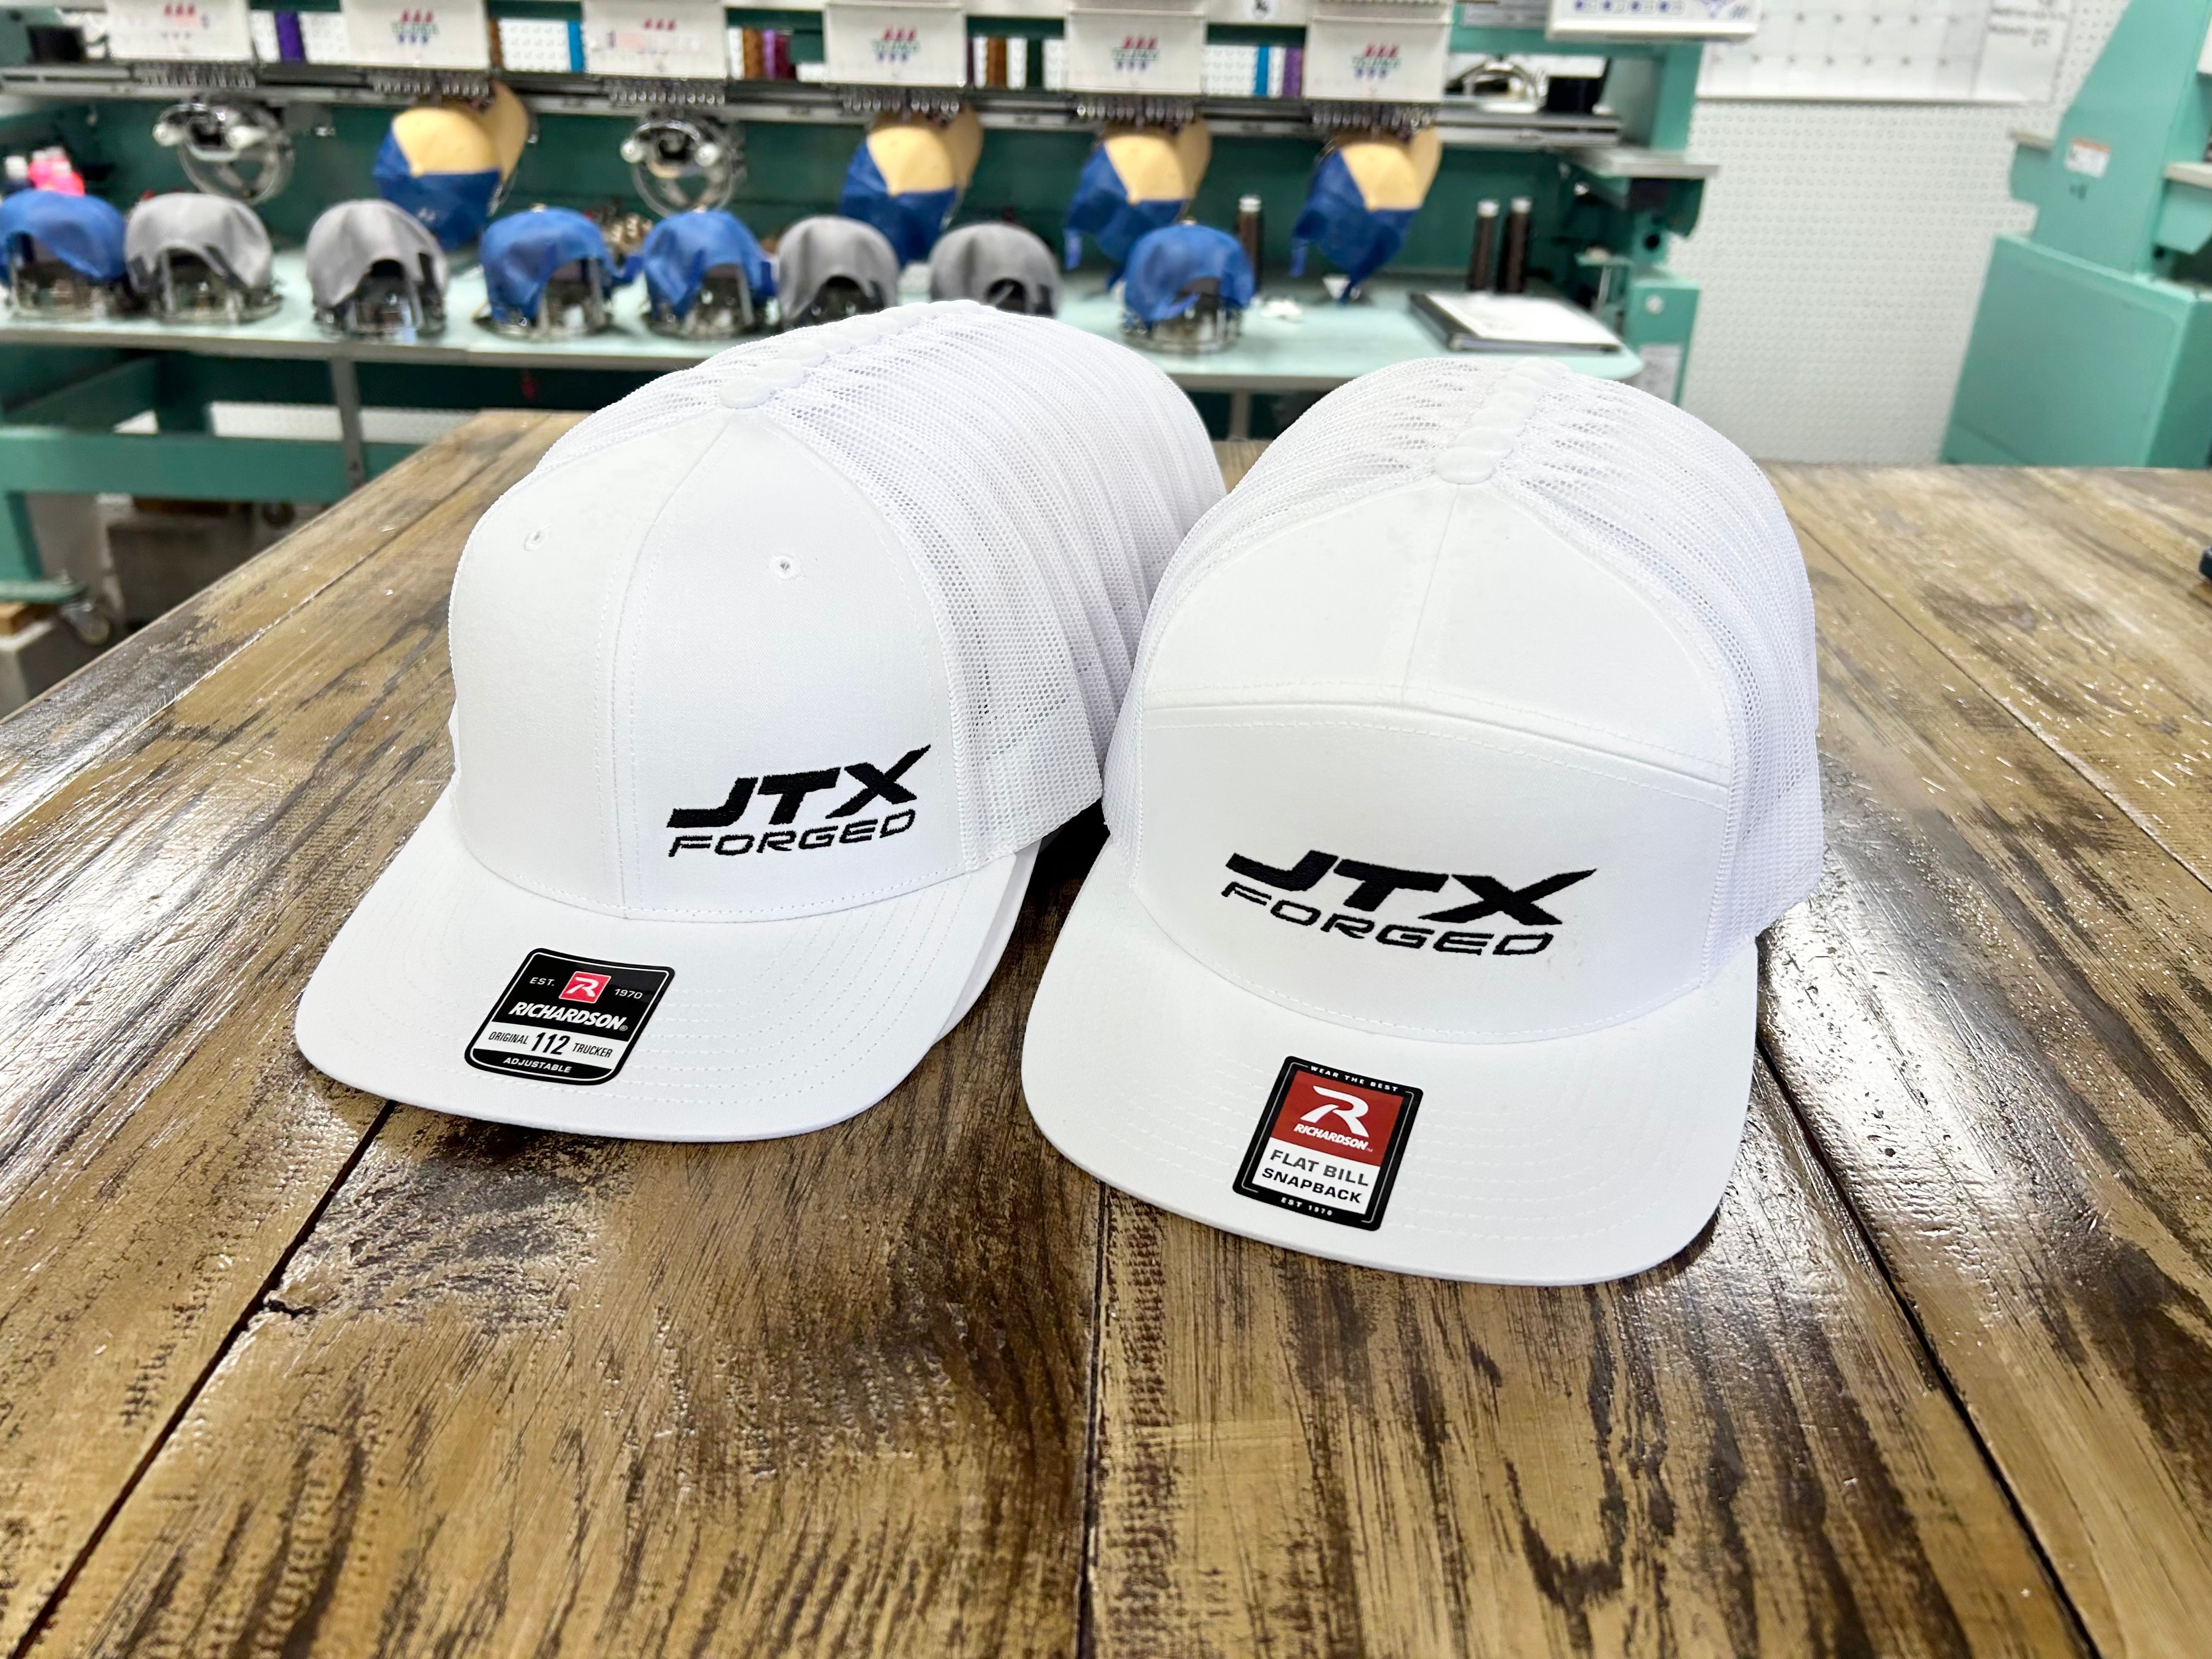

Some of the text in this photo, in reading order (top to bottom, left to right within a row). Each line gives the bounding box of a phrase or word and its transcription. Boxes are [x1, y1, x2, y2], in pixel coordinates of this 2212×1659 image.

[666, 744, 931, 828] JTX
[668, 809, 916, 857] FORGED
[1225, 849, 1597, 927] JTX
[1221, 881, 1554, 956] FORGED
[529, 977, 555, 987] EST.
[614, 988, 643, 1000] 1970
[488, 1031, 613, 1058] ORIGINAL 112 TRUCKER
[503, 1057, 572, 1074] ADJUSTABLE
[1310, 1065, 1399, 1092] WEAR THE BEST
[1294, 1124, 1369, 1150] RICHARDSON
[1269, 1149, 1369, 1187] FLAT BILL
[1262, 1167, 1362, 1204] SNAPBACK
[1280, 1197, 1303, 1207] EST
